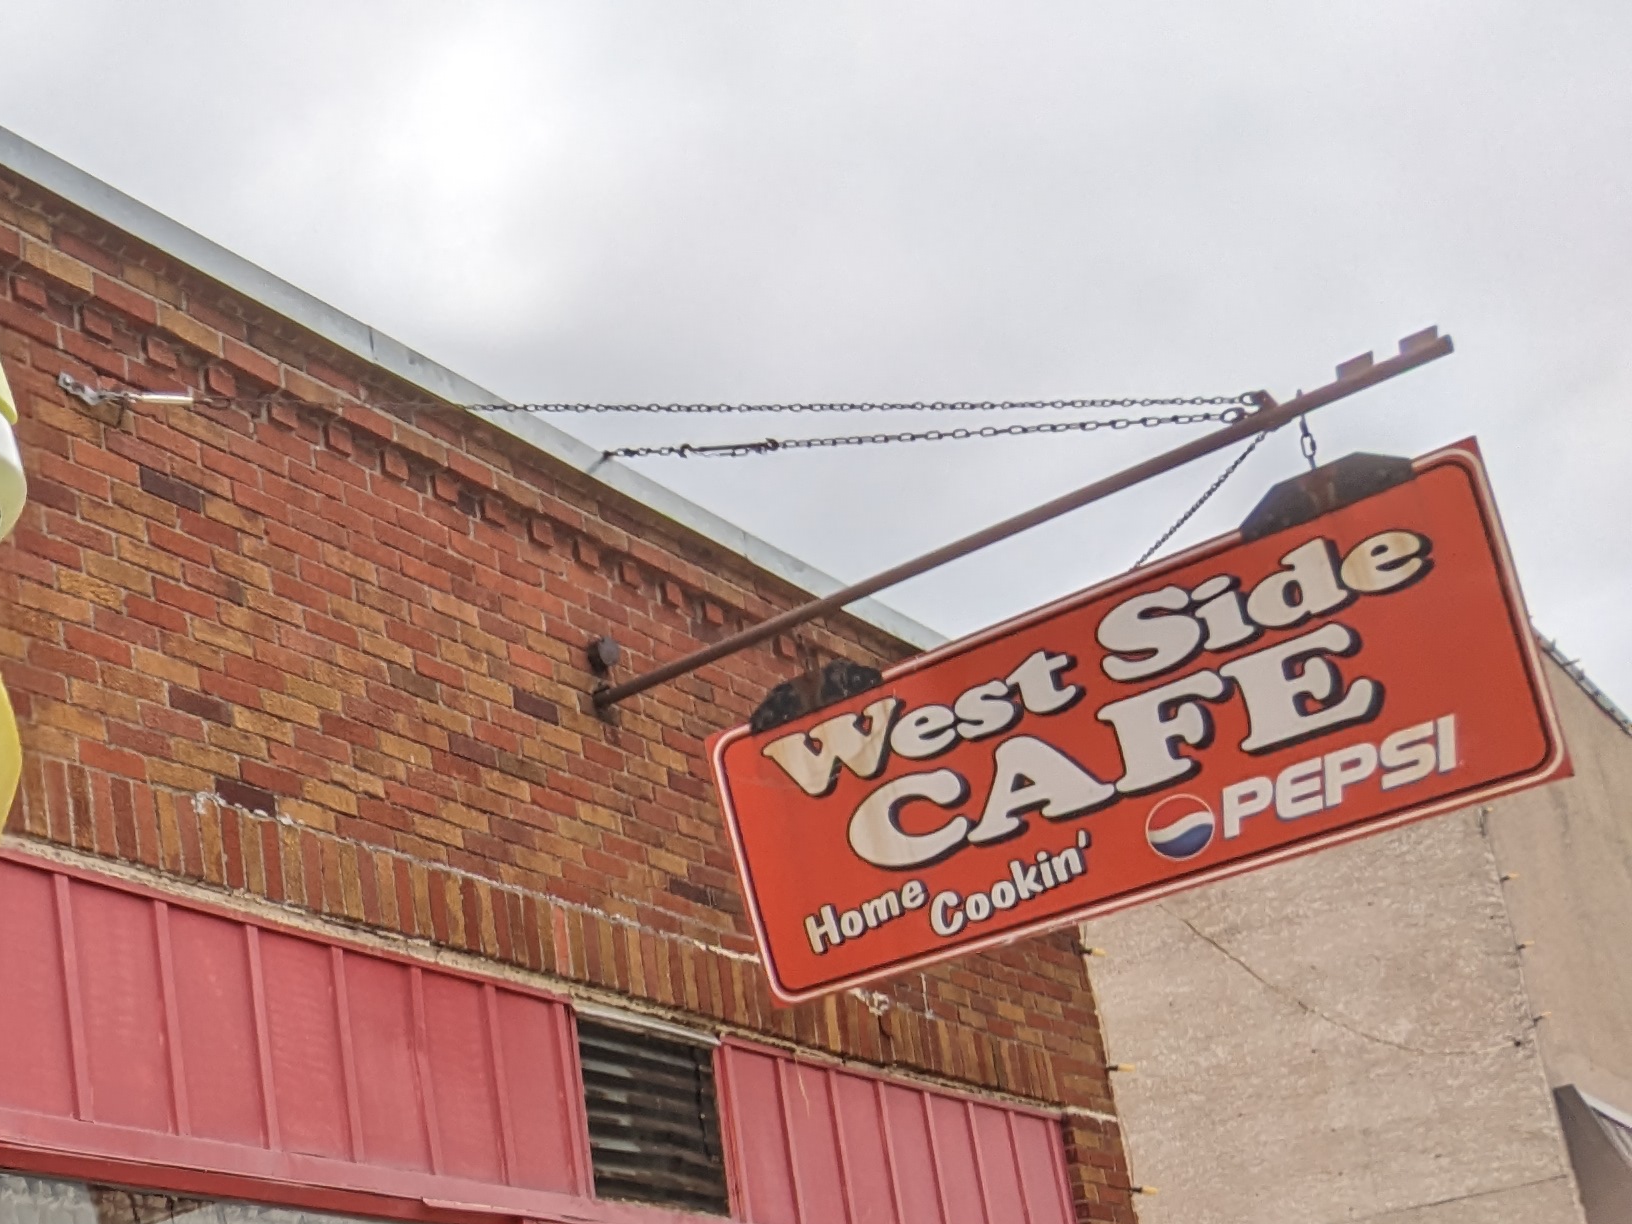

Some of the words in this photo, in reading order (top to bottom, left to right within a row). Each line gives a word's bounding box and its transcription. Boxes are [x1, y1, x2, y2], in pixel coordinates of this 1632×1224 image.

[762, 650, 1086, 797] West
[1095, 528, 1434, 682] Side
[847, 622, 1386, 868] CAFE
[1220, 713, 1458, 840] PEPSI
[803, 878, 930, 955] Home
[929, 828, 1092, 937] Cookin'
